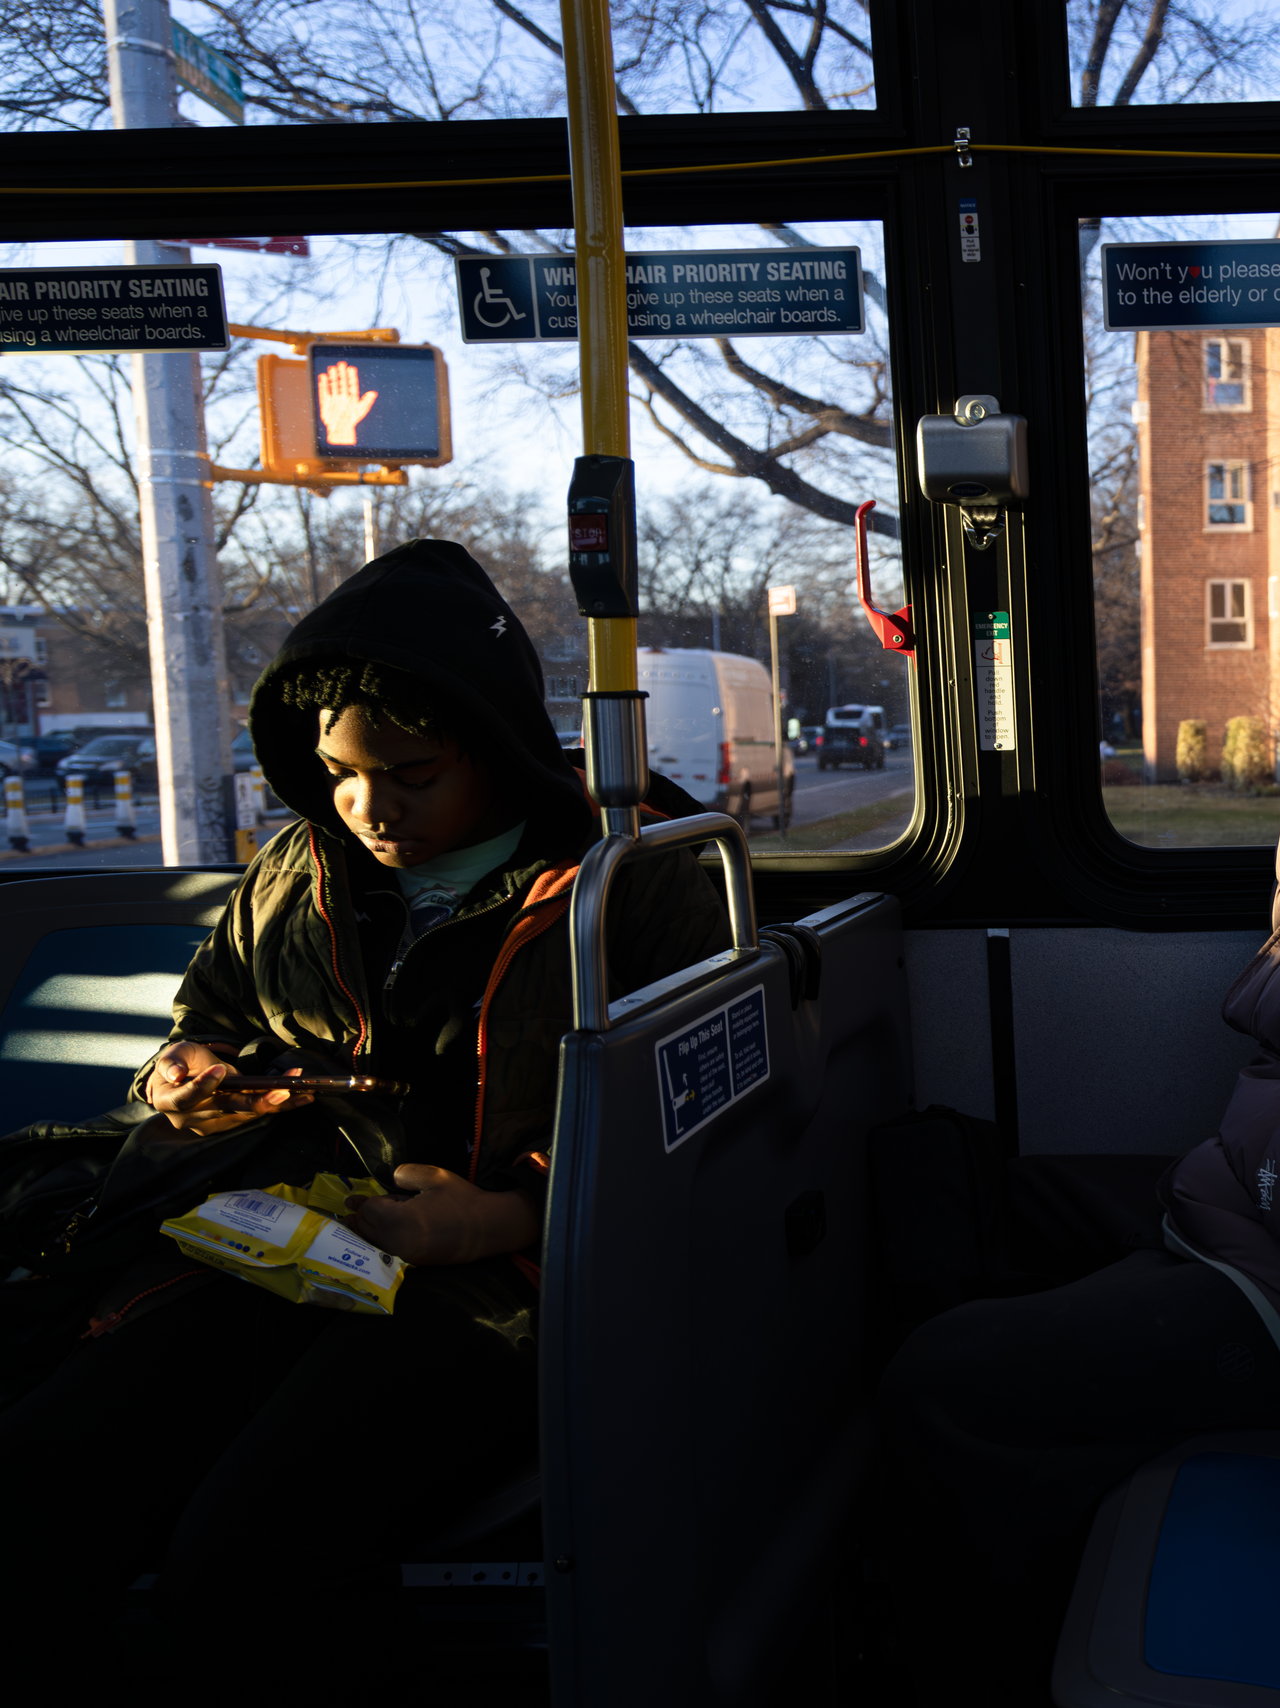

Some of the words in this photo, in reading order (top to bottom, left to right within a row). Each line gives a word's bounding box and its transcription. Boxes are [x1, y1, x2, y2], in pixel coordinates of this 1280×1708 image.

[672, 263, 760, 283] PRIORITY
[766, 260, 847, 281] SEATING
[1116, 263, 1172, 281] Won't
[35, 280, 123, 300] PRIORITY
[128, 278, 209, 298] SEATING
[545, 291, 577, 307] You
[627, 290, 659, 310] give
[663, 291, 685, 308] up
[689, 288, 733, 304] these
[738, 288, 780, 303] seats
[785, 286, 829, 301] when
[833, 289, 844, 301] a
[1116, 289, 1137, 306] to
[1142, 287, 1173, 304] the
[1178, 286, 1241, 307] elderly
[1248, 288, 1268, 302] or
[28, 309, 48, 324] up
[52, 305, 97, 320] these
[101, 306, 144, 320] seats
[149, 303, 193, 318] when
[197, 305, 208, 318] a
[628, 310, 671, 330] using
[675, 313, 687, 326] a
[690, 308, 776, 325] wheelchair
[780, 307, 841, 324] boards.
[41, 329, 52, 342] a
[54, 324, 141, 342] wheelchair
[145, 323, 205, 340] boards.
[574, 528, 602, 538] STOP
[986, 629, 999, 637] EXIT
[678, 1041, 690, 1056] Flip
[689, 1035, 698, 1050] Up
[698, 1027, 710, 1043] This
[710, 1019, 724, 1036] Seat
